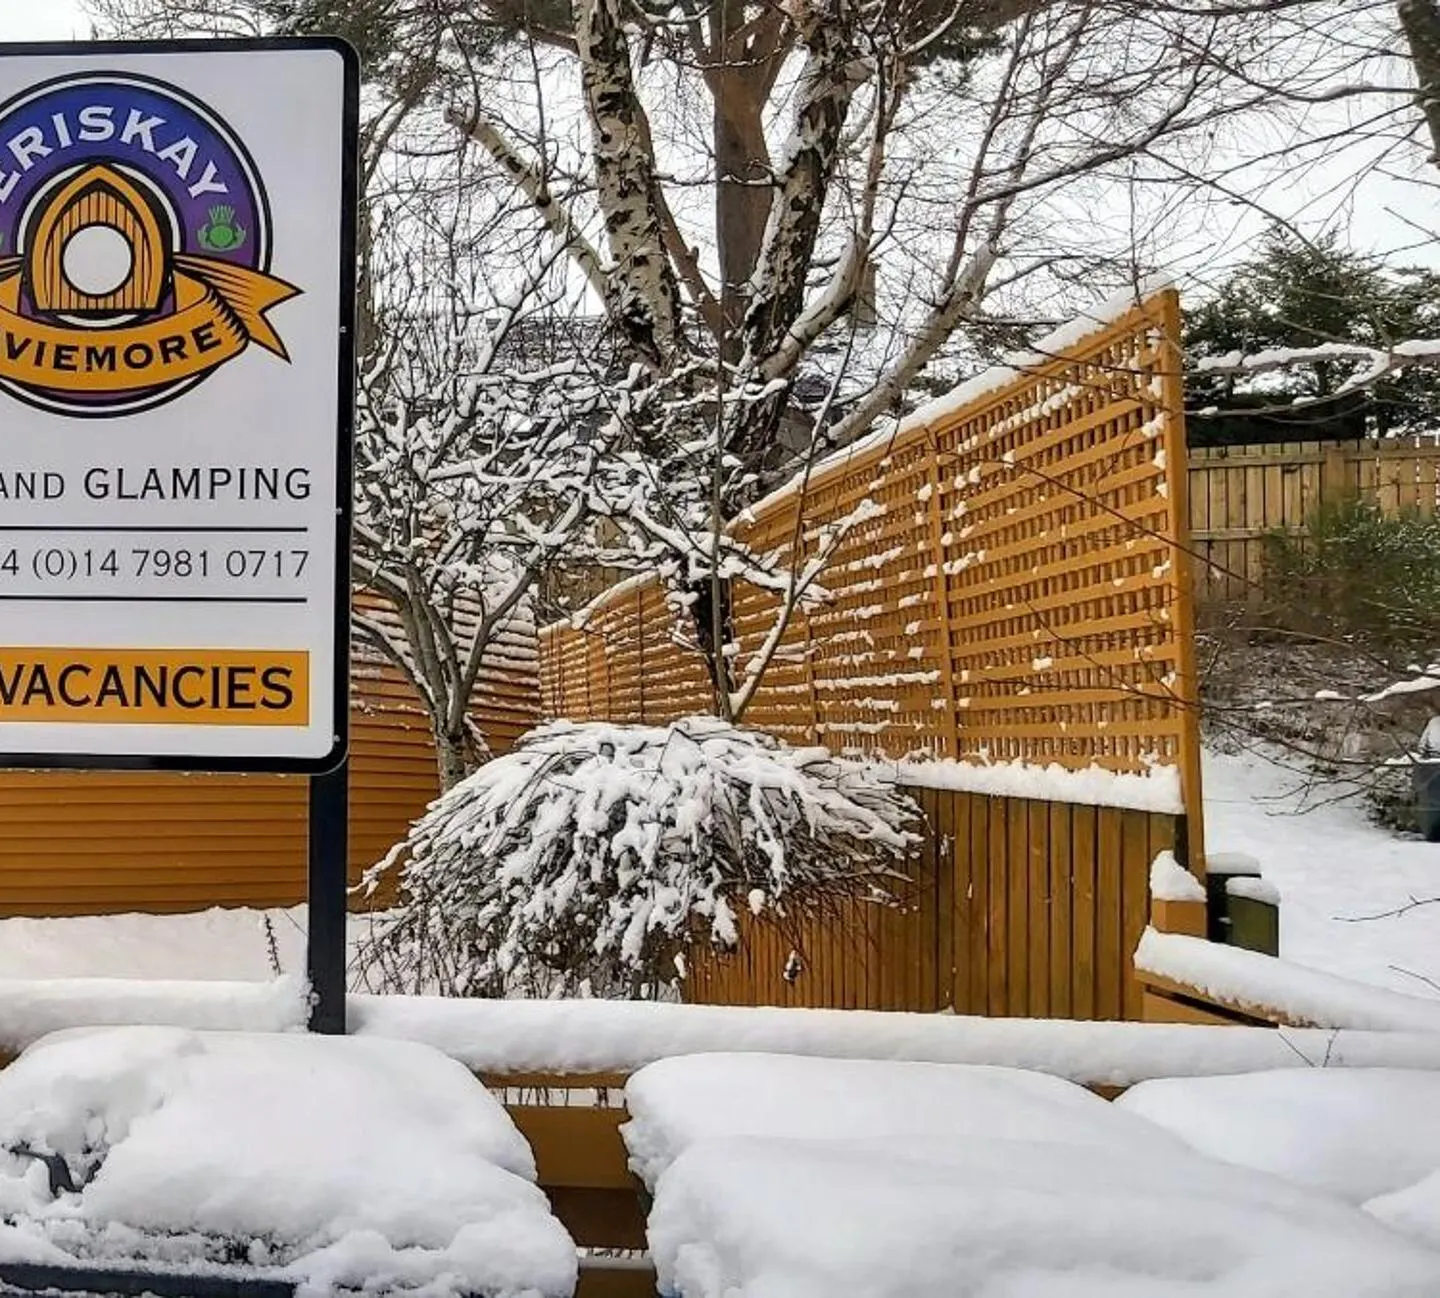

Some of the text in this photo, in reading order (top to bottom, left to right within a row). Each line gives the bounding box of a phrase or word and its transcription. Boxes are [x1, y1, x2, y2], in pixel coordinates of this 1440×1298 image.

[83, 467, 312, 501] GLAMPING
[32, 548, 120, 580] (0)14
[132, 549, 210, 578] 7981
[225, 549, 310, 579] 0717
